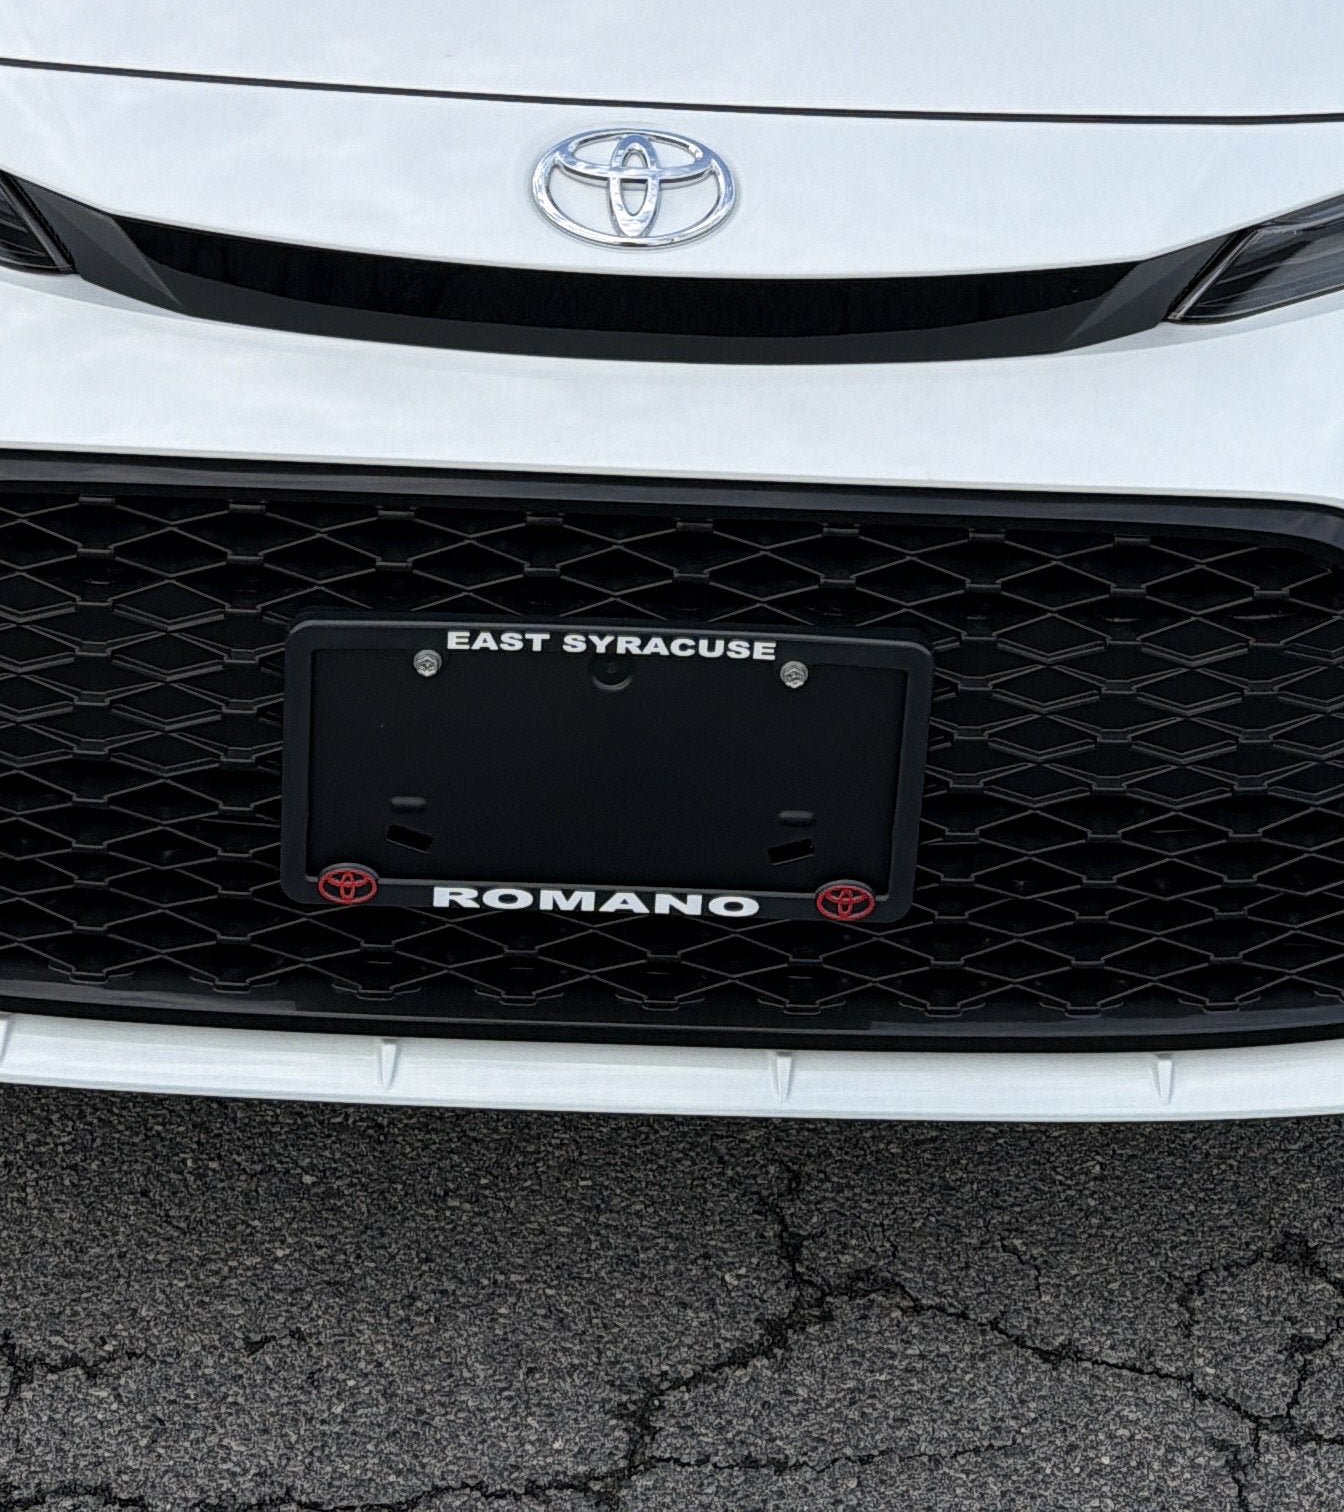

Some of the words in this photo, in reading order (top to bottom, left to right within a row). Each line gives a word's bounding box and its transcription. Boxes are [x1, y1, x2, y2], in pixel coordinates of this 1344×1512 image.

[447, 631, 550, 652] EAST
[562, 634, 777, 661] SYRACUSE
[432, 886, 760, 918] ROMANO
